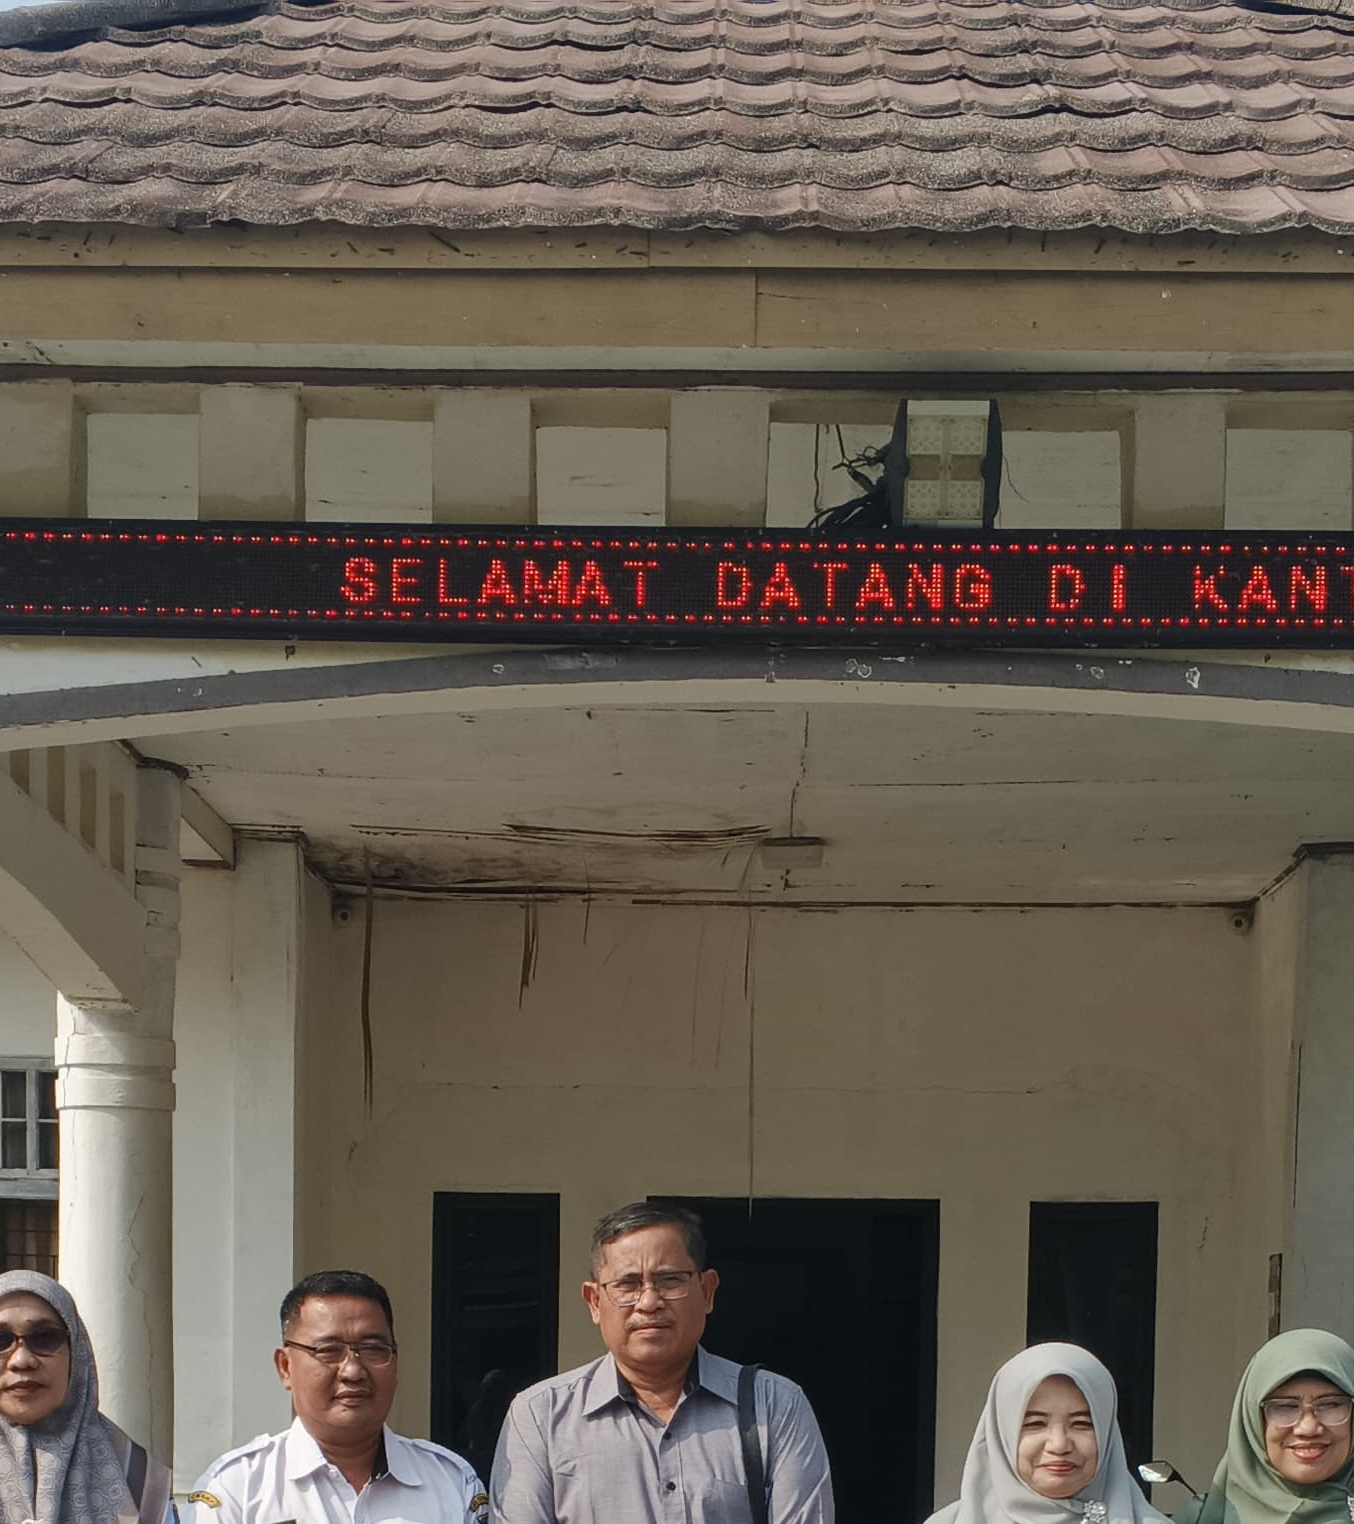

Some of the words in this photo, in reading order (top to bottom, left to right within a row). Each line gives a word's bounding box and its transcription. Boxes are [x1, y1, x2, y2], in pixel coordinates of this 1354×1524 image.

[340, 555, 660, 608] SELAMAT
[716, 560, 994, 612] DATANG
[1048, 562, 1128, 613] DI
